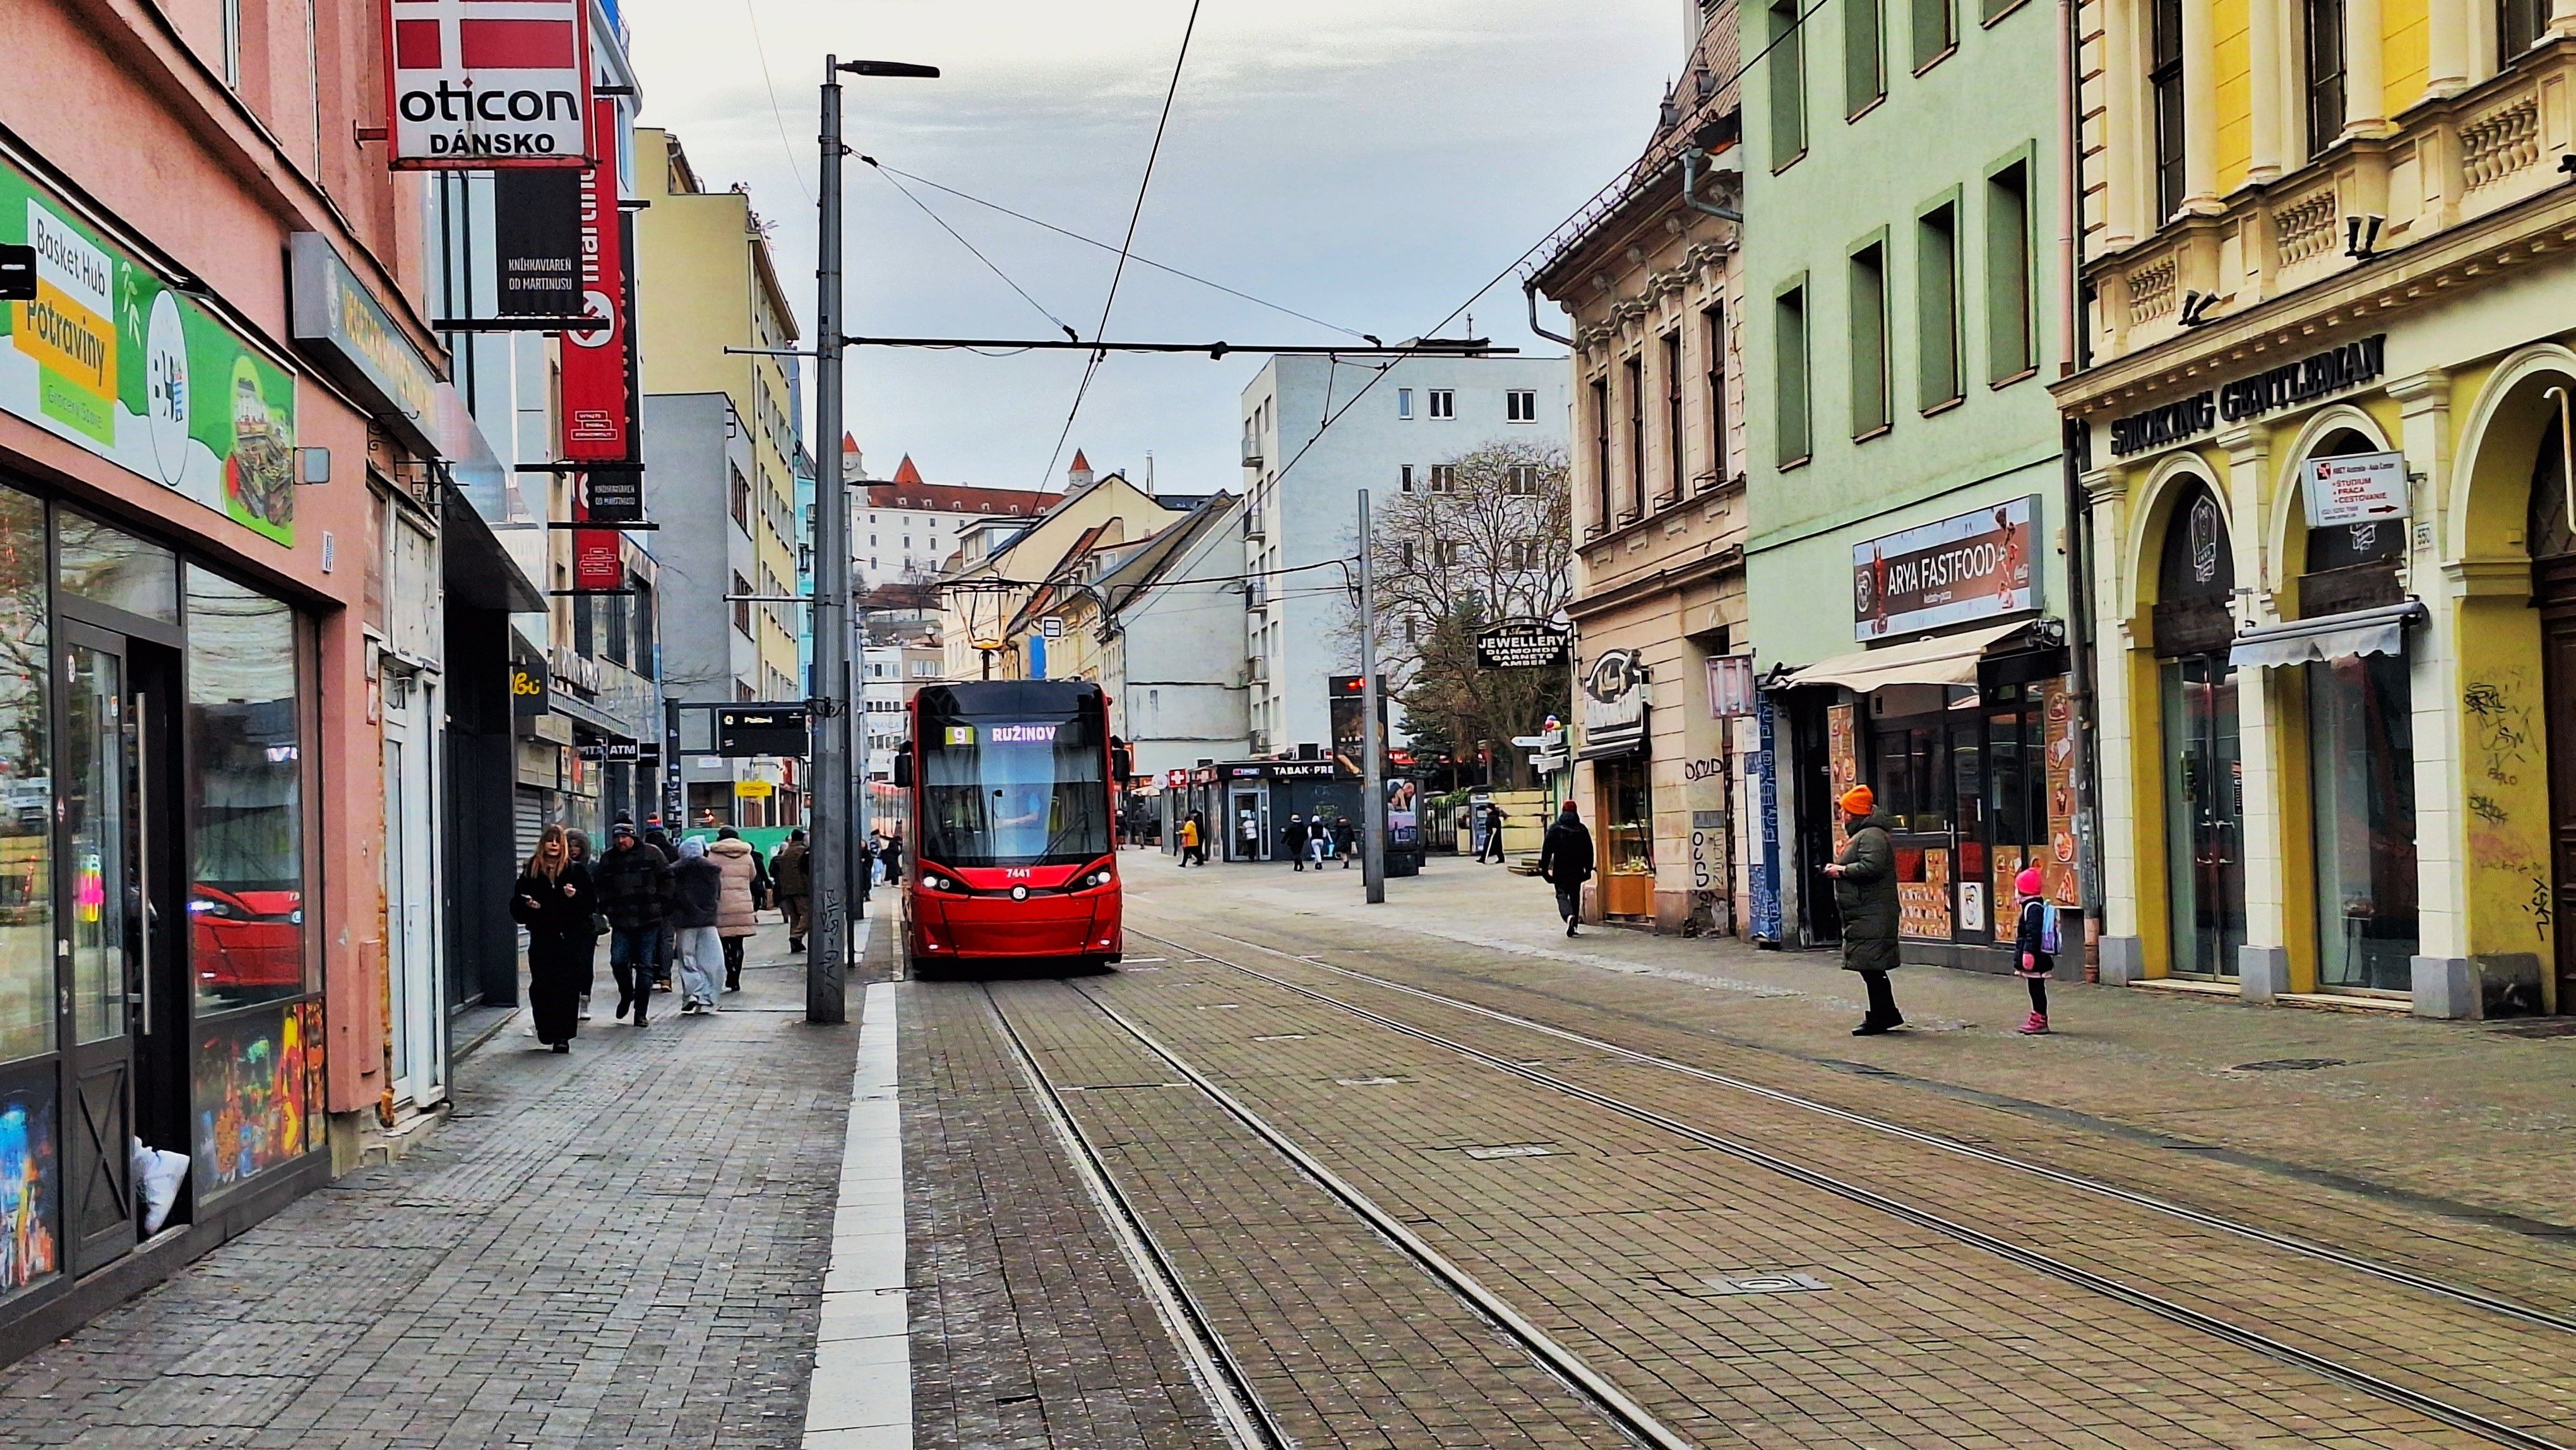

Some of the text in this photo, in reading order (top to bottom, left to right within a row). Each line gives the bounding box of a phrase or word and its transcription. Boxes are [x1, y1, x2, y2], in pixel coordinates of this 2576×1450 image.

[399, 77, 580, 123] oticon
[429, 129, 556, 154] DÁNSKO
[37, 218, 105, 297] Basket Hub
[509, 277, 572, 291] OD MARTINUSU
[27, 299, 105, 387] Potraviny
[2111, 333, 2387, 455] SMOKING GENTLEMAN
[1887, 561, 1919, 596] ARYA
[1921, 542, 1996, 589] FASTFOOD
[1478, 635, 1566, 649] JEWELLERY
[1486, 647, 1559, 656] DIAMONDS
[1492, 653, 1554, 661] GARNETS
[954, 725, 1056, 743] 9 RUŽINOV
[609, 745, 636, 755] ATM
[1273, 765, 1310, 776] TABAK
[1005, 868, 1030, 878] 7441
